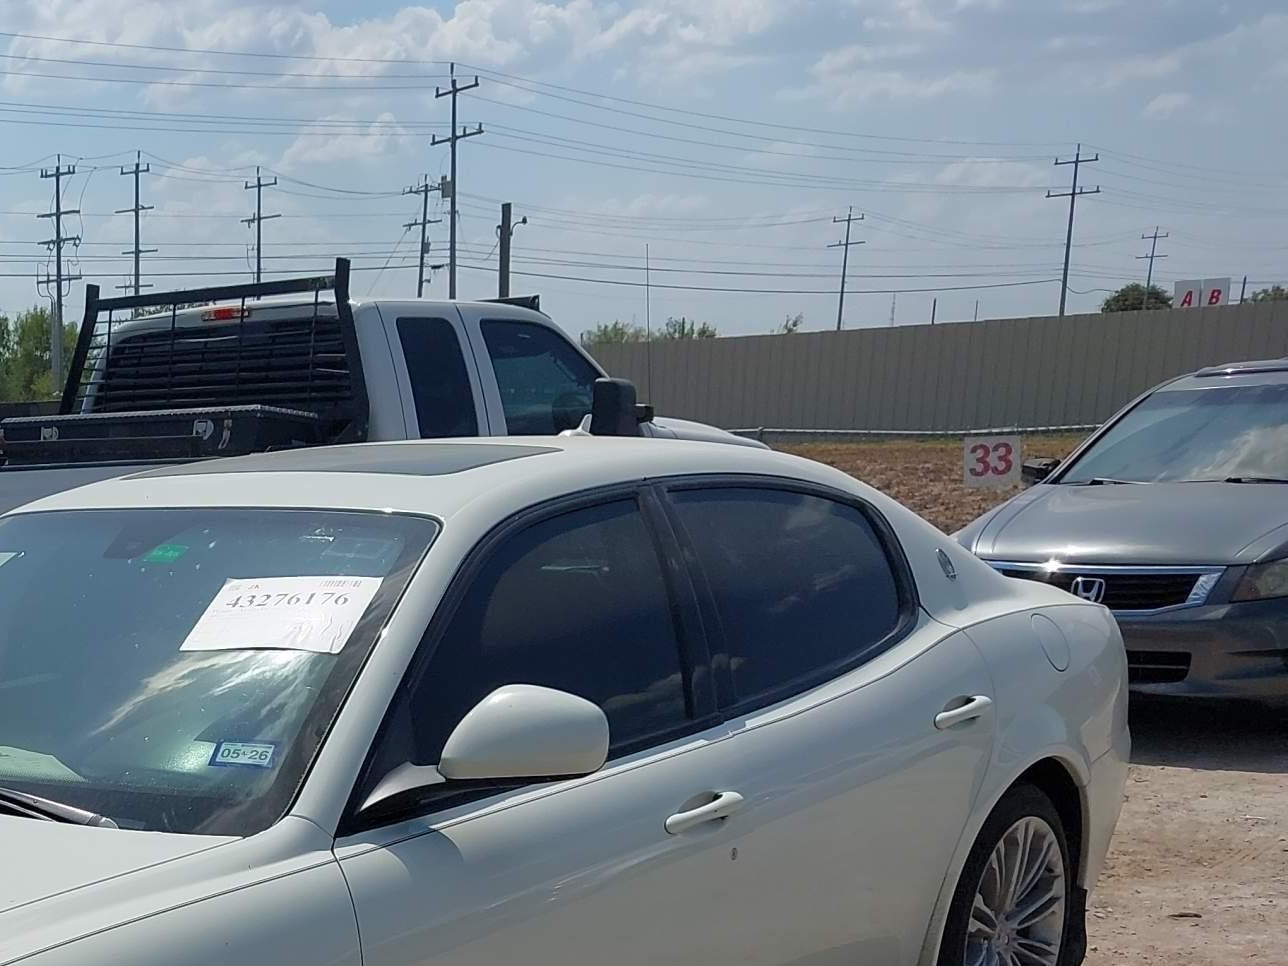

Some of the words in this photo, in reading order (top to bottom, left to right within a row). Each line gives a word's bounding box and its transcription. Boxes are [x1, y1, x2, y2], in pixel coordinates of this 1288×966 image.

[1180, 290, 1193, 307] A
[1208, 288, 1222, 305] B
[969, 442, 1013, 477] 33
[226, 592, 350, 608] 43276176
